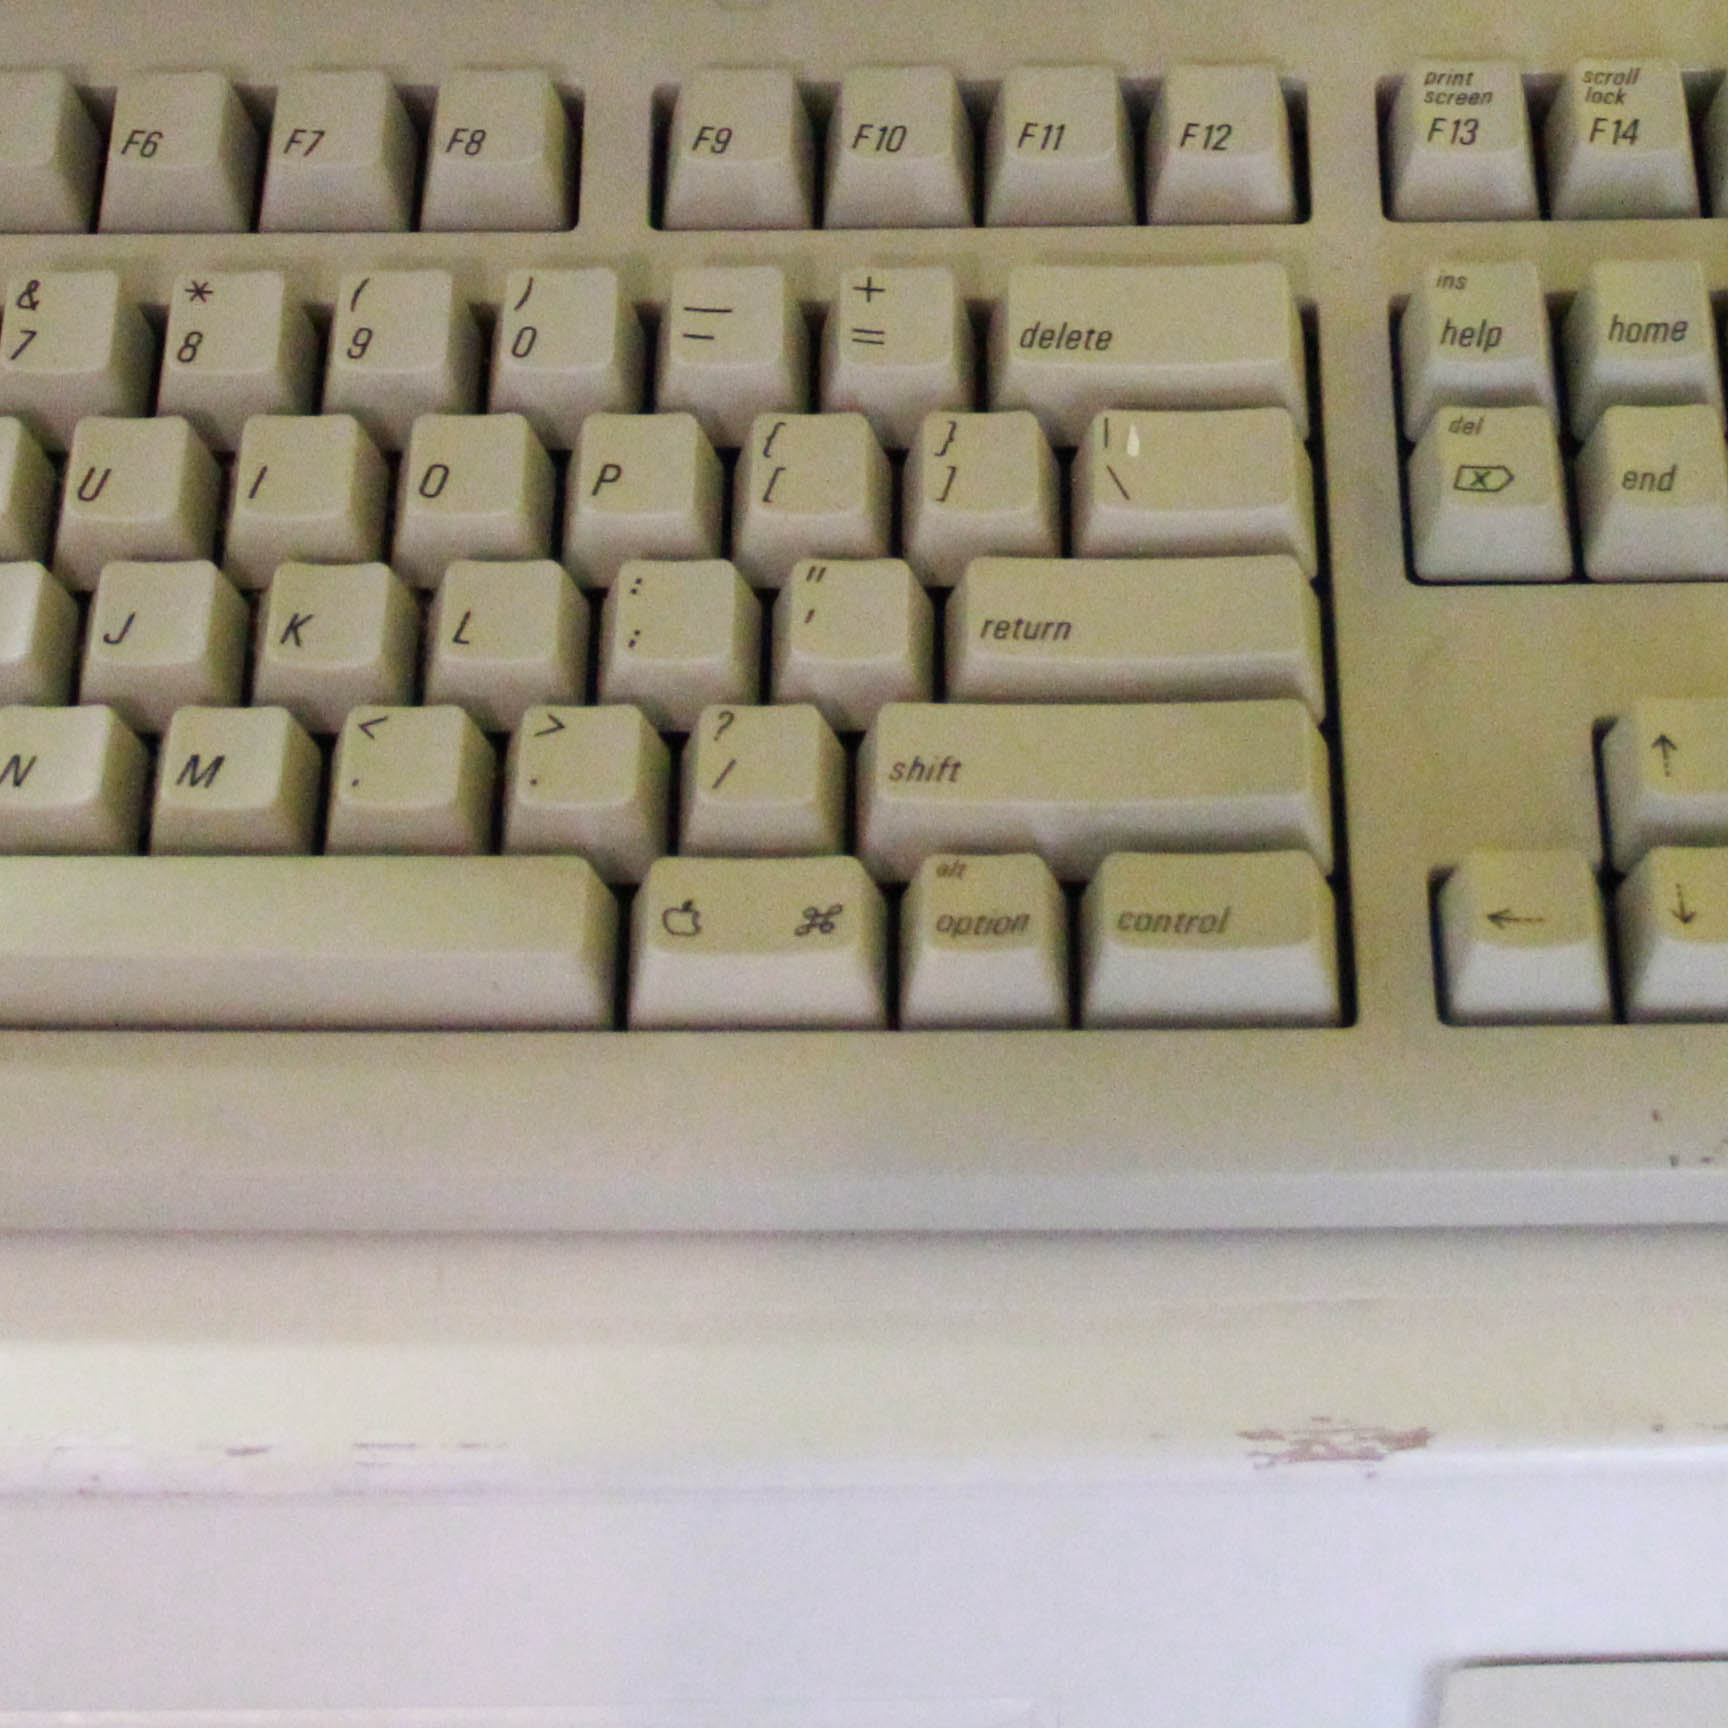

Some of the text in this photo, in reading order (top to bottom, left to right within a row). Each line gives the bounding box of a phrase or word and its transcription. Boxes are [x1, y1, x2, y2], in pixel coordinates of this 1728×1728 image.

[1423, 68, 1473, 88] print
[1581, 66, 1639, 86] scroll
[1423, 88, 1493, 107] screen
[1585, 87, 1627, 106] lock
[121, 131, 163, 158] F6
[283, 130, 325, 156] F7
[446, 130, 487, 156] F8
[692, 127, 733, 154] F9
[852, 125, 907, 153] F10
[1017, 124, 1064, 152] F11
[1180, 123, 1232, 151] F12
[1428, 118, 1479, 147] F13
[1589, 118, 1639, 146] F14
[17, 280, 41, 310] &
[352, 278, 370, 310] (
[515, 276, 532, 309] )
[853, 276, 885, 303] +
[1435, 272, 1467, 291] ins
[347, 328, 372, 359] 9
[851, 328, 886, 345] =
[1020, 321, 1112, 352] delete
[1440, 319, 1503, 352] help
[1608, 317, 1688, 343] home
[10, 331, 37, 361] 7
[178, 332, 203, 363] 8
[763, 421, 787, 457] {
[935, 421, 957, 457] }
[1449, 416, 1483, 436] del
[77, 468, 110, 501] U
[591, 465, 622, 497] P
[762, 467, 787, 503] [
[935, 467, 955, 501] ]
[1621, 466, 1677, 493] end
[103, 613, 136, 646] J
[281, 613, 313, 647] K
[453, 611, 473, 645] L
[980, 615, 1073, 643] return
[358, 715, 388, 740] <
[534, 714, 566, 738] >
[713, 711, 735, 742] ?
[176, 755, 225, 788] M
[888, 757, 962, 784] shift
[936, 909, 1029, 937] option
[1116, 906, 1232, 937] control
